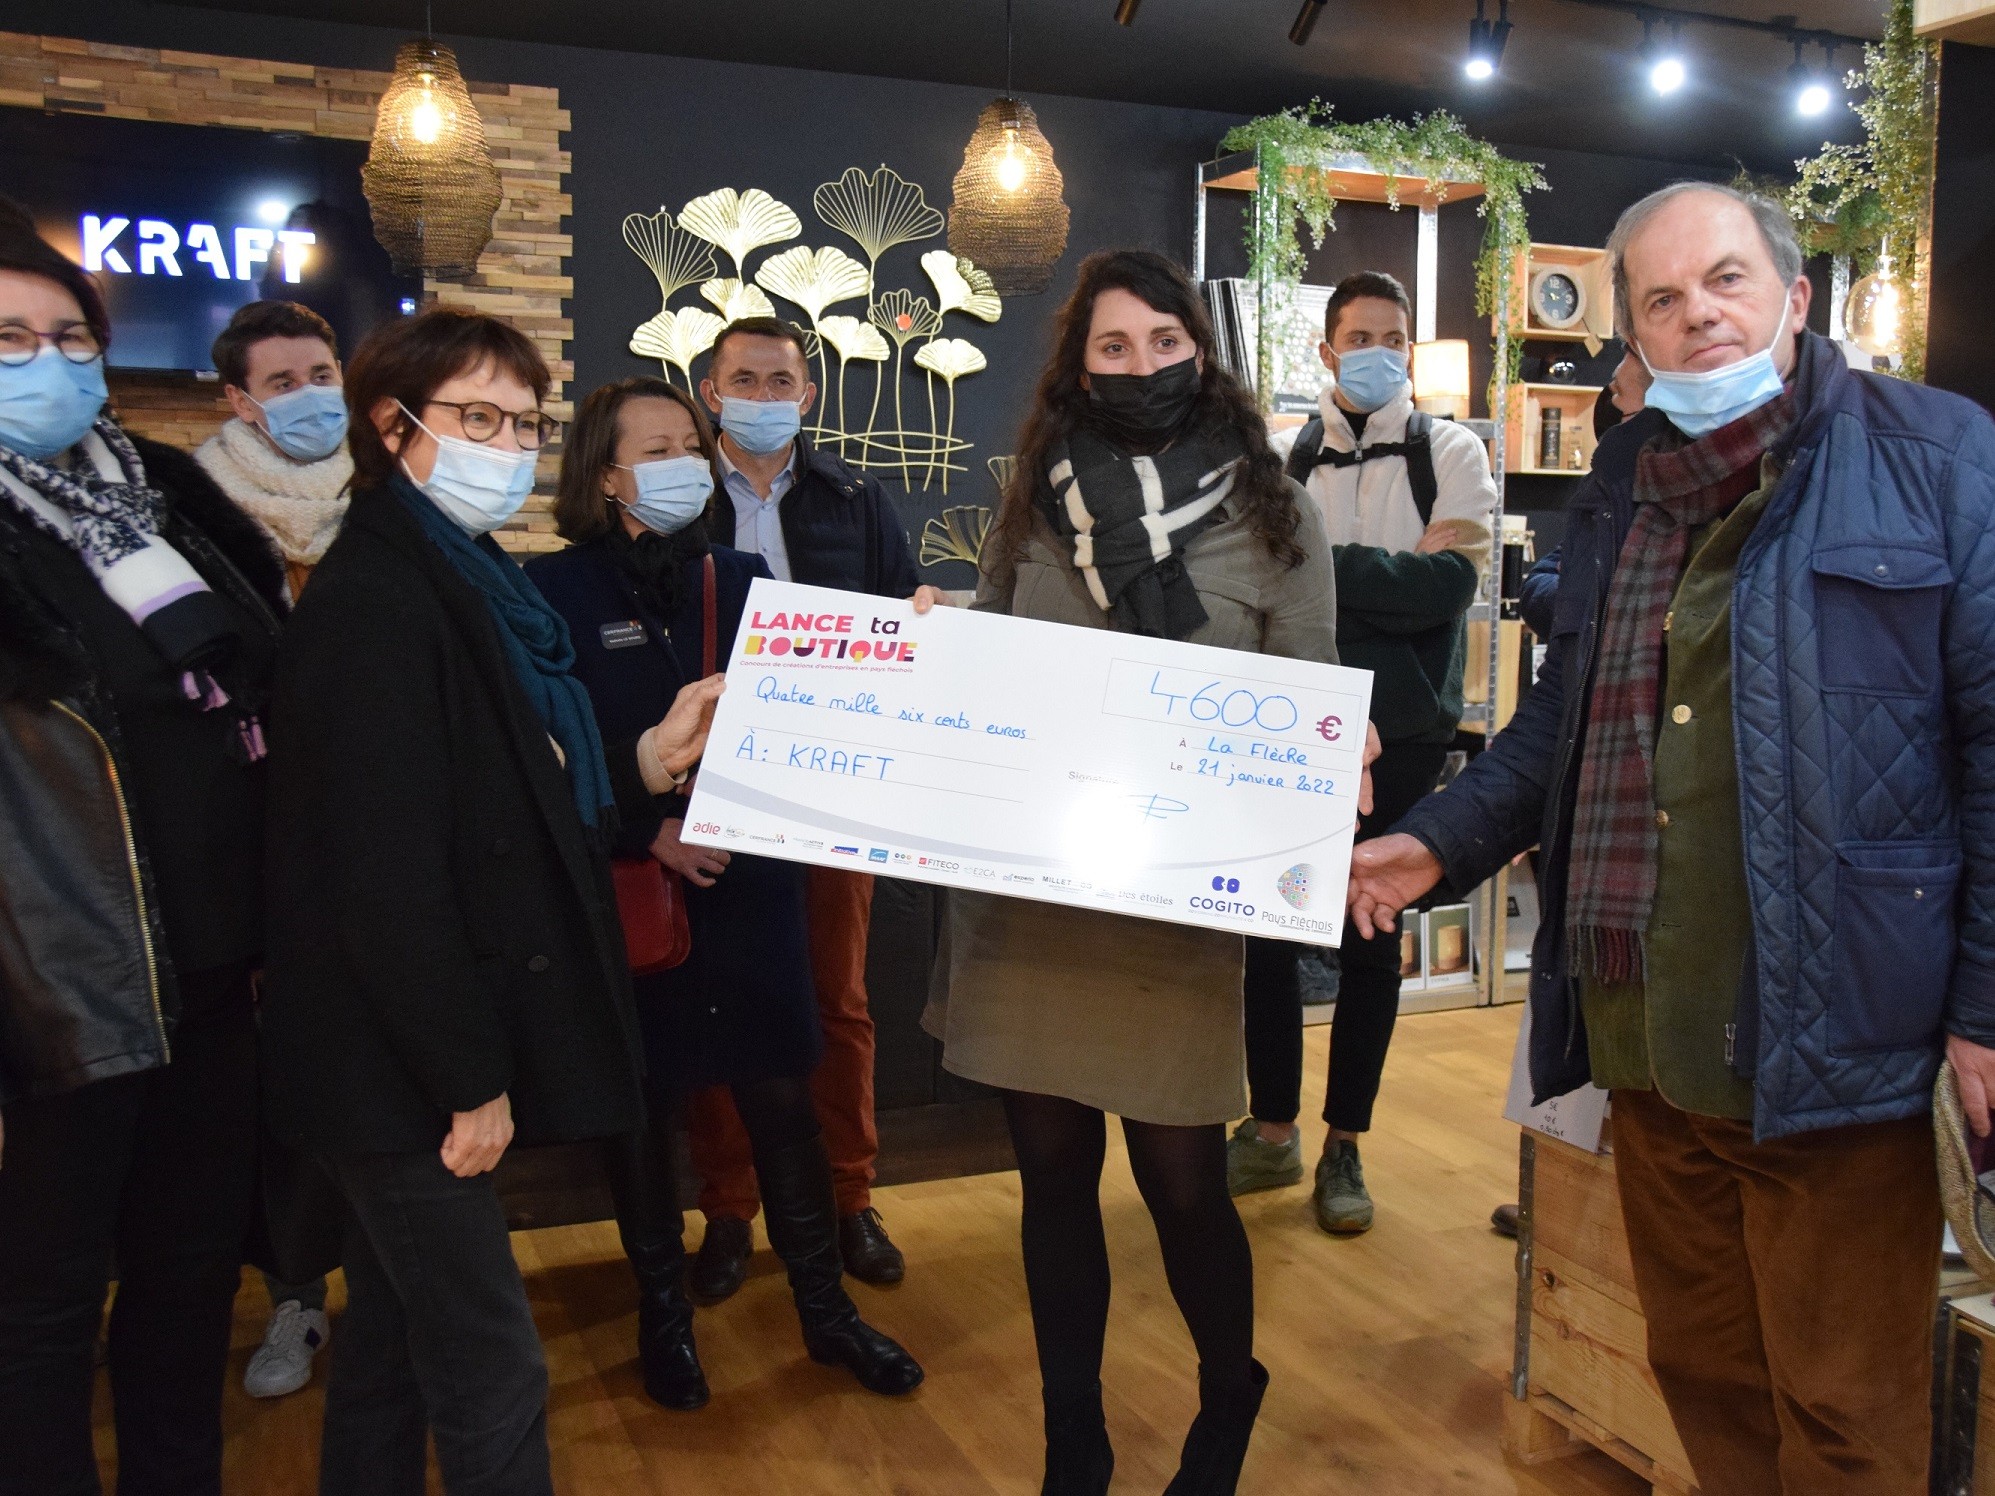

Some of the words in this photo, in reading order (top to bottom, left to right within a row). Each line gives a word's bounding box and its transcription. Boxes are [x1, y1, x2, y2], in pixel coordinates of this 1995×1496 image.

[81, 214, 317, 284] KRAFT
[751, 611, 854, 633] LANCE
[870, 616, 900, 635] ta
[744, 635, 918, 663] BOUTIQUE
[1150, 671, 1297, 731] 4600
[829, 692, 883, 715] mille
[898, 707, 924, 723] six
[934, 711, 970, 730] cents
[1315, 715, 1343, 742] €
[1179, 737, 1187, 748] À
[1208, 737, 1233, 754] La
[788, 743, 895, 781] KRAFT
[1170, 762, 1183, 772] Le
[1197, 758, 1219, 777] 21
[1296, 775, 1335, 796] 2022
[692, 821, 721, 836] adie
[927, 858, 960, 870] FITECO
[972, 867, 996, 878] E2CA
[1042, 875, 1072, 886] MILLET
[1140, 892, 1174, 906] étoiles
[1189, 896, 1256, 917] COGITO
[1261, 911, 1286, 925] Pays
